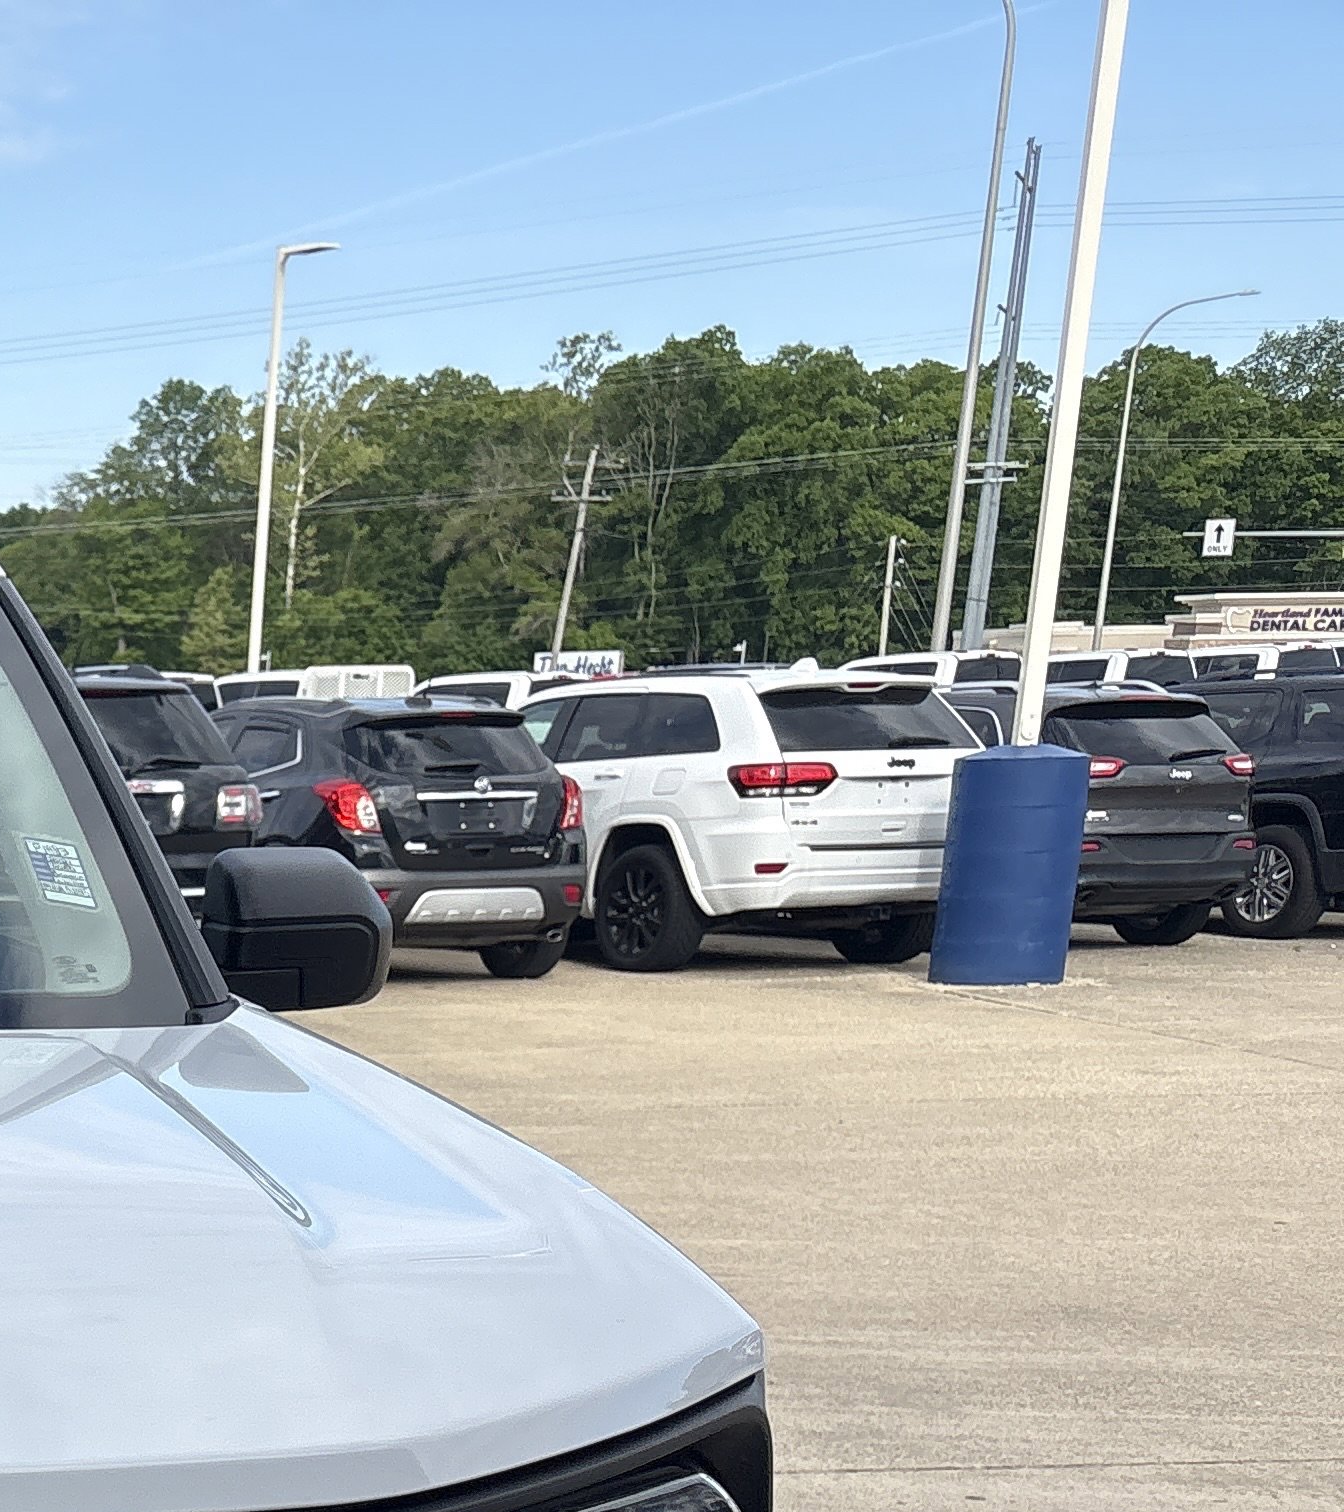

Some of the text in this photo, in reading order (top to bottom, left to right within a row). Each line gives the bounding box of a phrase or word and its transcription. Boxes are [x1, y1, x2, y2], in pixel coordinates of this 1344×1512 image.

[1207, 545, 1228, 553] ONLY
[1251, 608, 1344, 619] Heartland FAM
[1249, 619, 1309, 632] DENTAL
[887, 756, 916, 770] Jeep
[1169, 768, 1193, 780] Jeep
